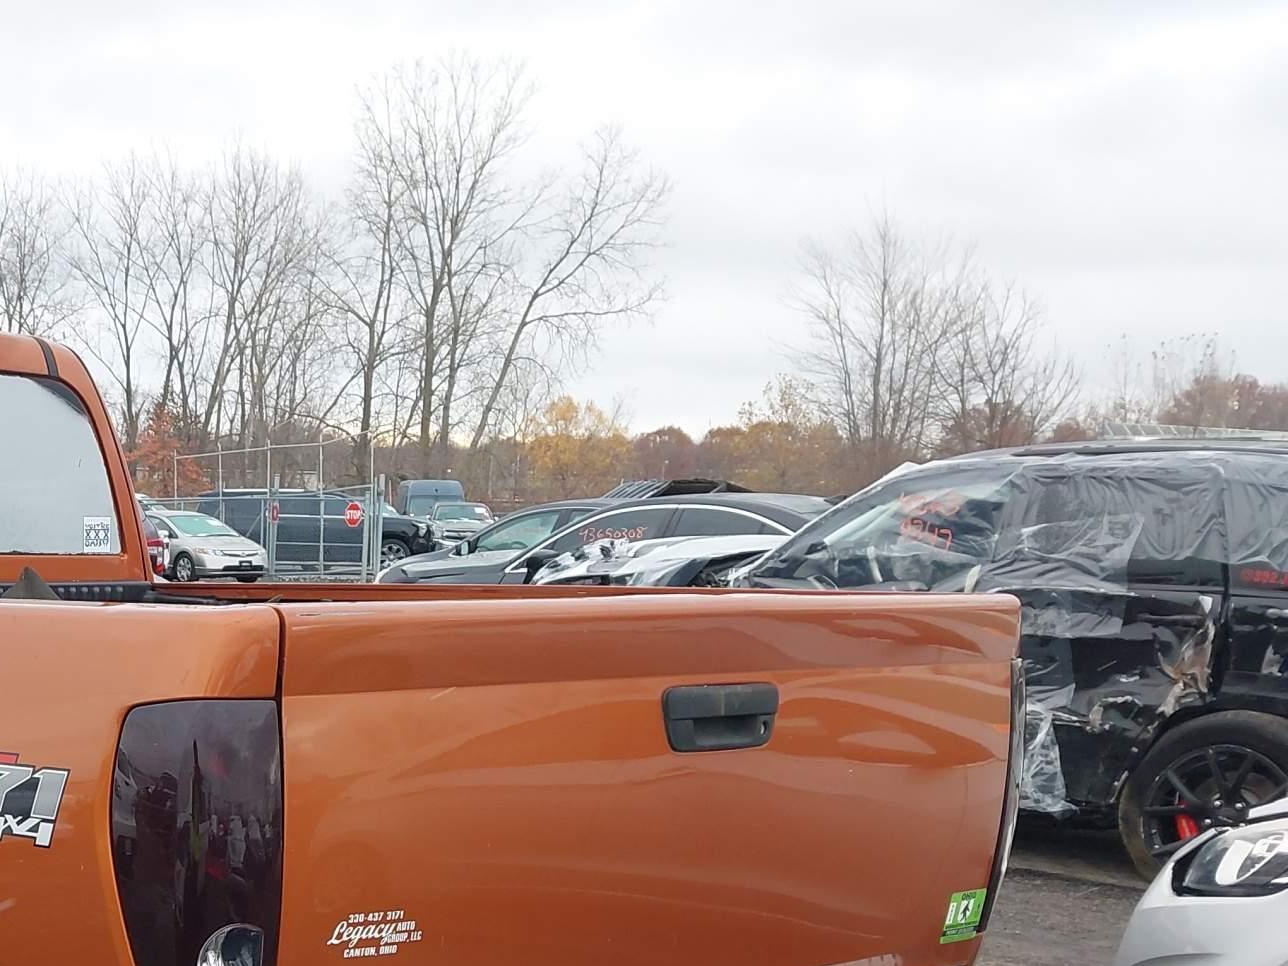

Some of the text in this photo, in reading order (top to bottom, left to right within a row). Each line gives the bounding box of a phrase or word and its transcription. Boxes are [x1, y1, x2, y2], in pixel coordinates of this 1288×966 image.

[346, 509, 362, 520] STOP
[386, 910, 405, 920] 3171
[326, 920, 416, 948] Legacy AUTO
[410, 930, 423, 941] LLC
[343, 944, 398, 959] CANTON, OHIO
